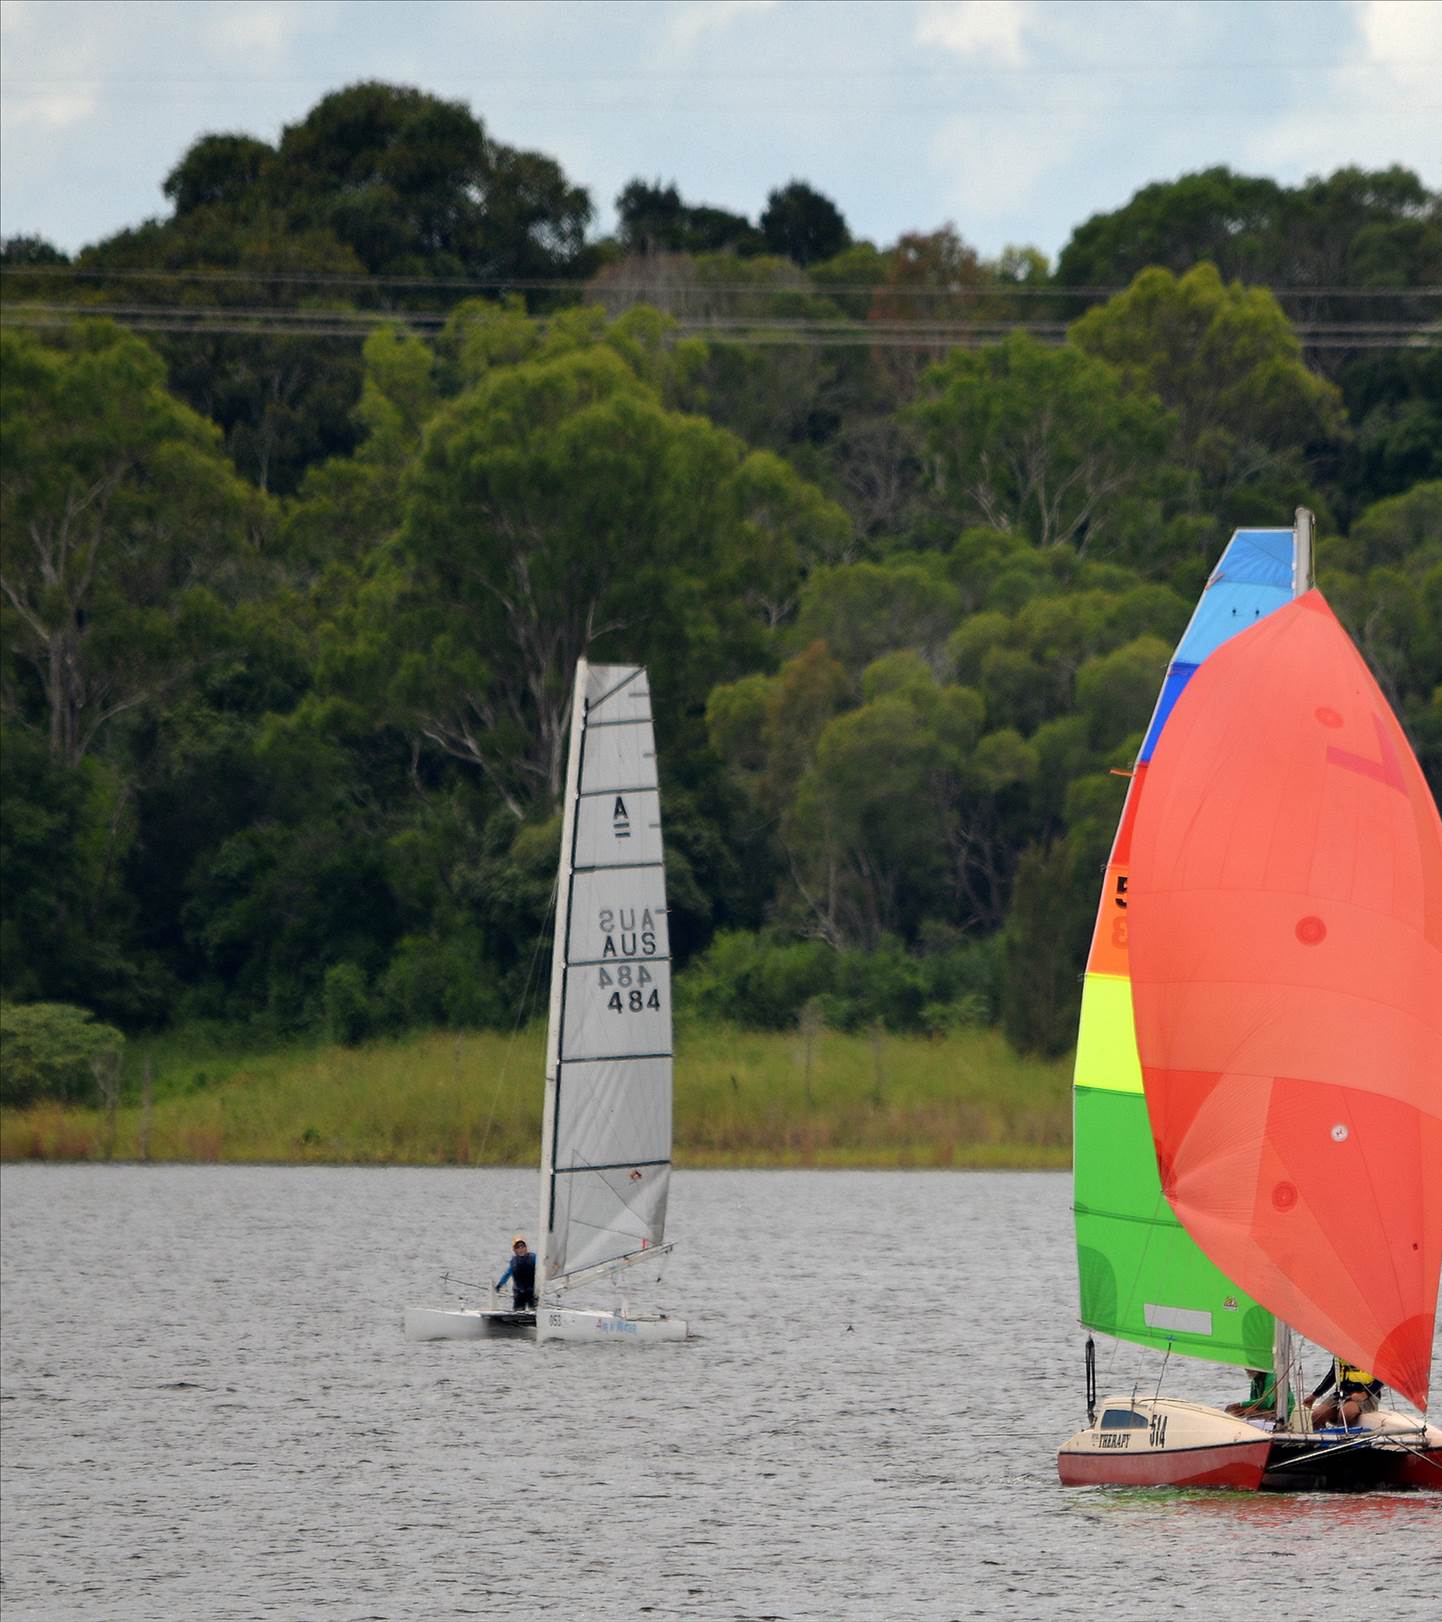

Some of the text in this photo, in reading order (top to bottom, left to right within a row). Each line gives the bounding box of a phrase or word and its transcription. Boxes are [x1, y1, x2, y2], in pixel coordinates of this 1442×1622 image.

[613, 796, 628, 819] A
[603, 931, 656, 957] AUS
[608, 988, 660, 1014] 484
[1099, 1433, 1131, 1449] THERAPY
[1149, 1414, 1168, 1449] 514
